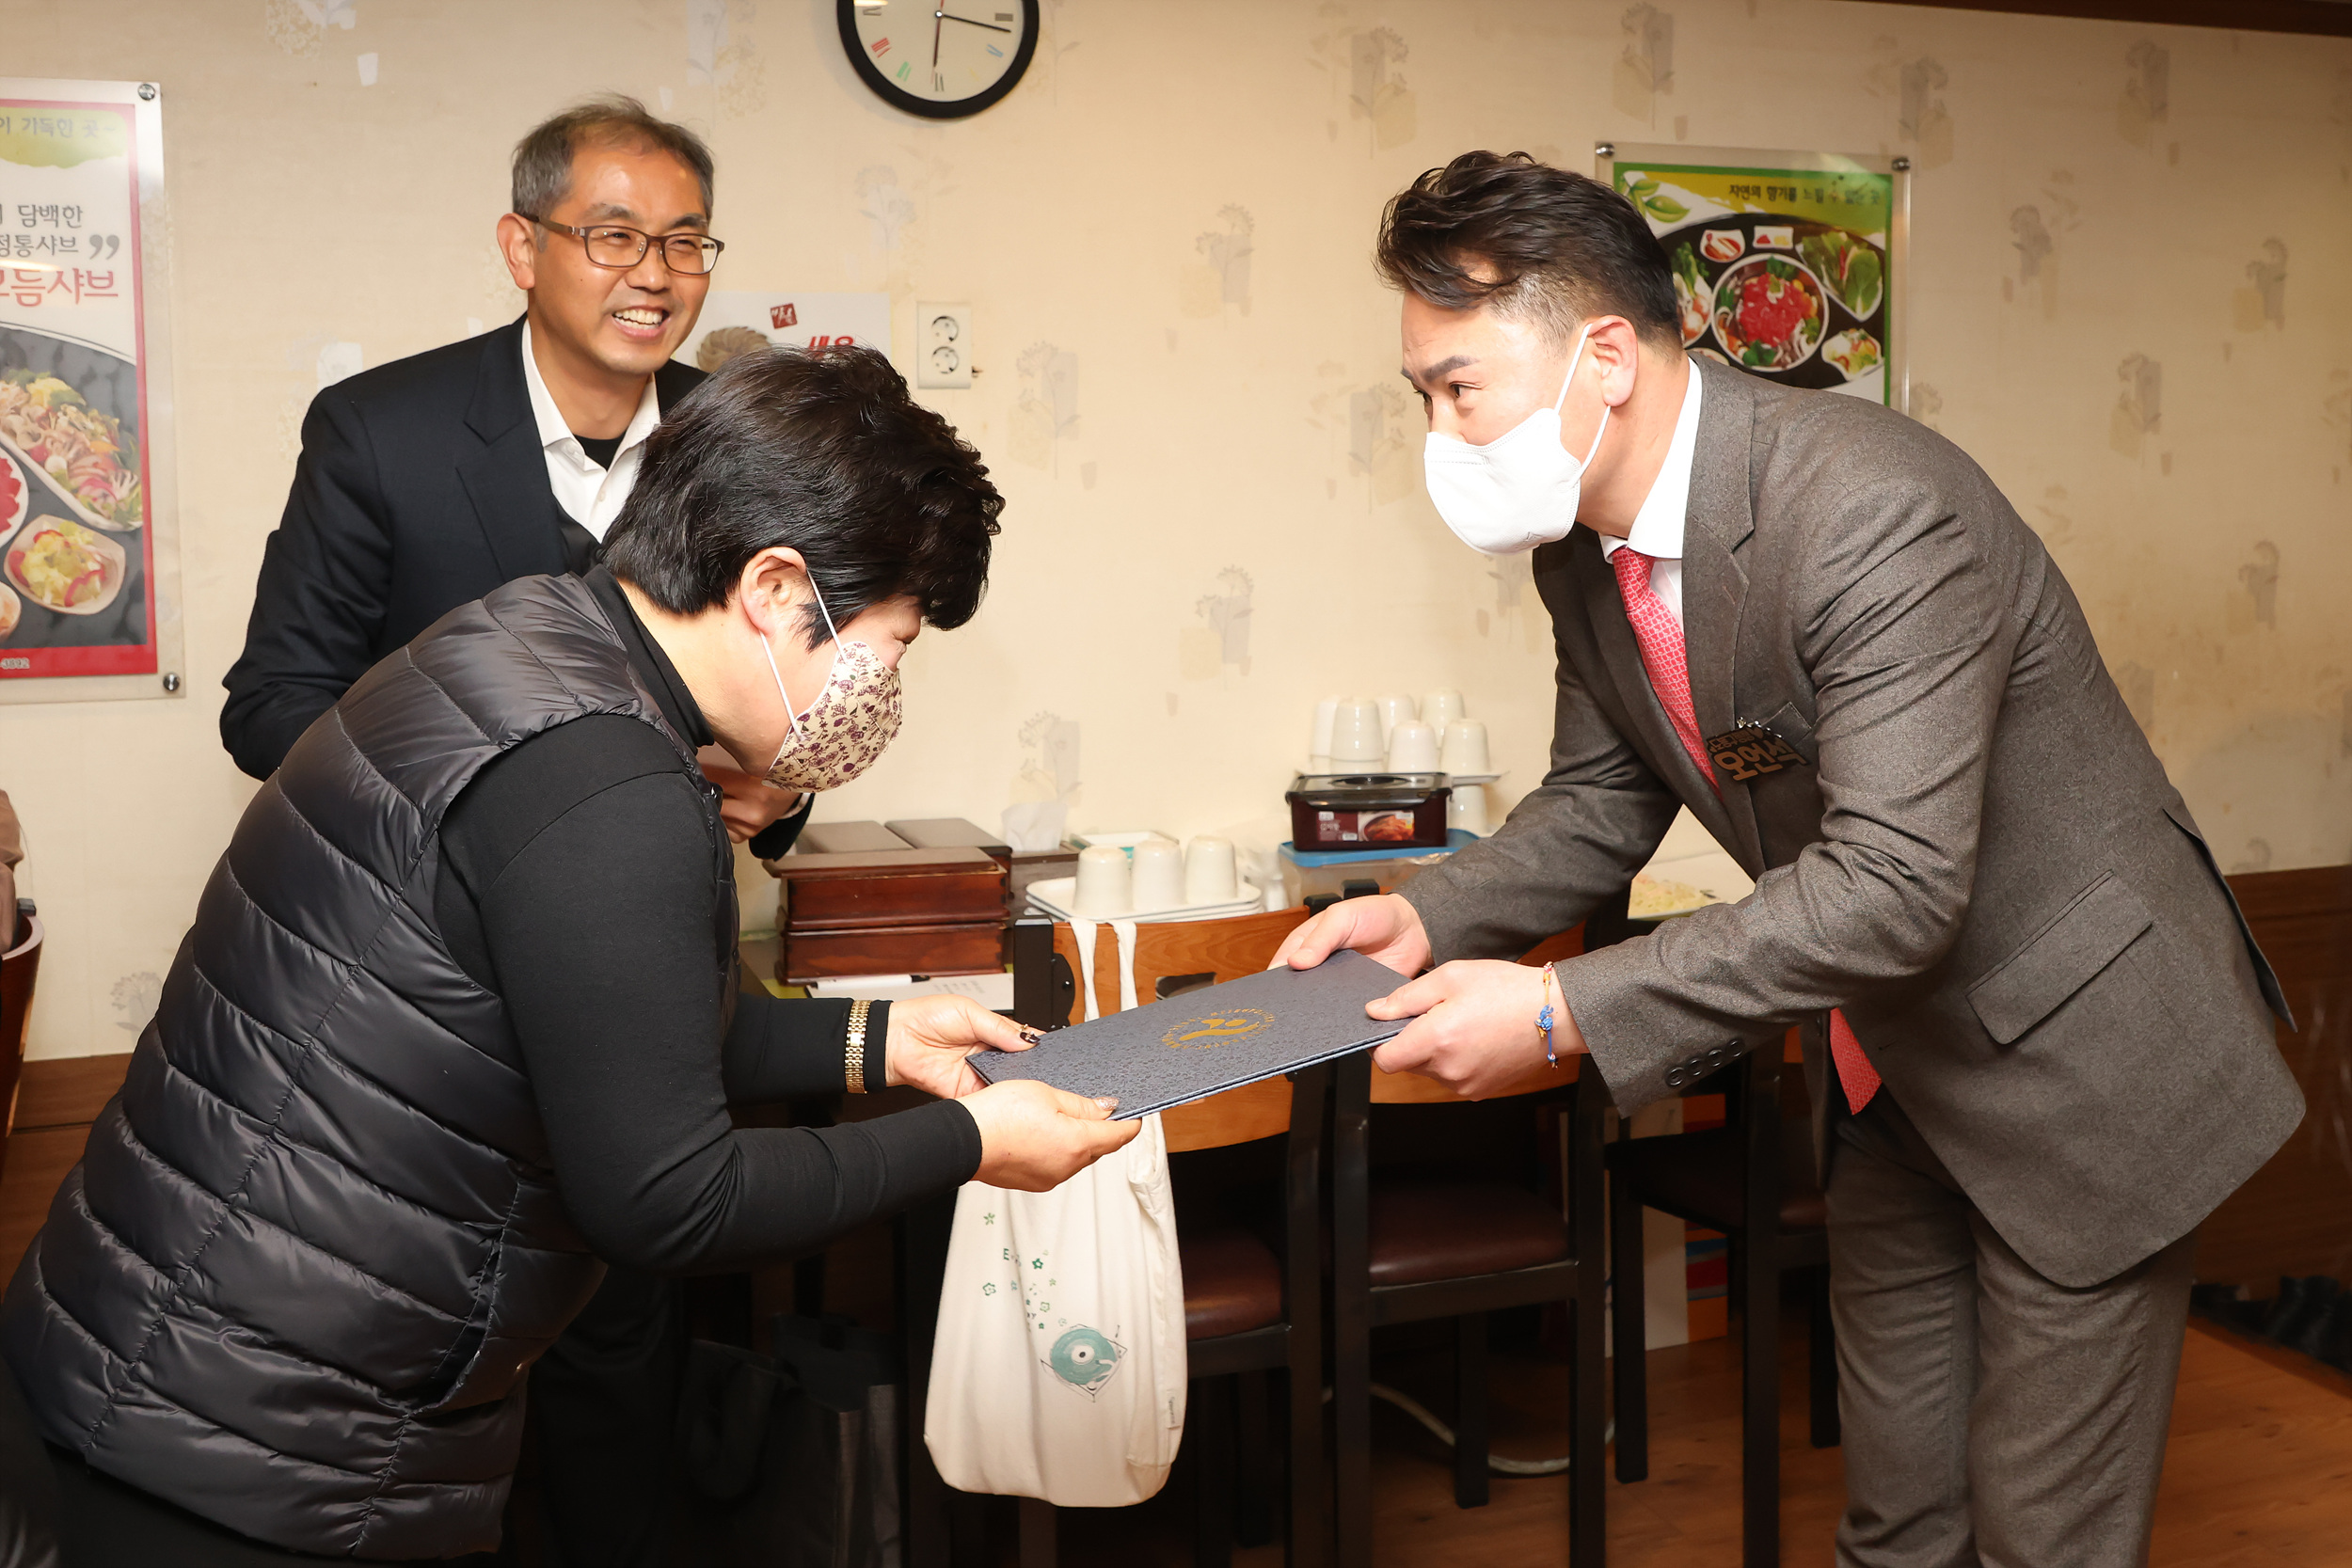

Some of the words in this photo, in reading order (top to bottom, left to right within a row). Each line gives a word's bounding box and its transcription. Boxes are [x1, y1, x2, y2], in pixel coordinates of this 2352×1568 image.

[18, 203, 84, 229] 담백한
[0, 267, 119, 308] 듬샤브
[1712, 736, 1808, 782] 오언석
